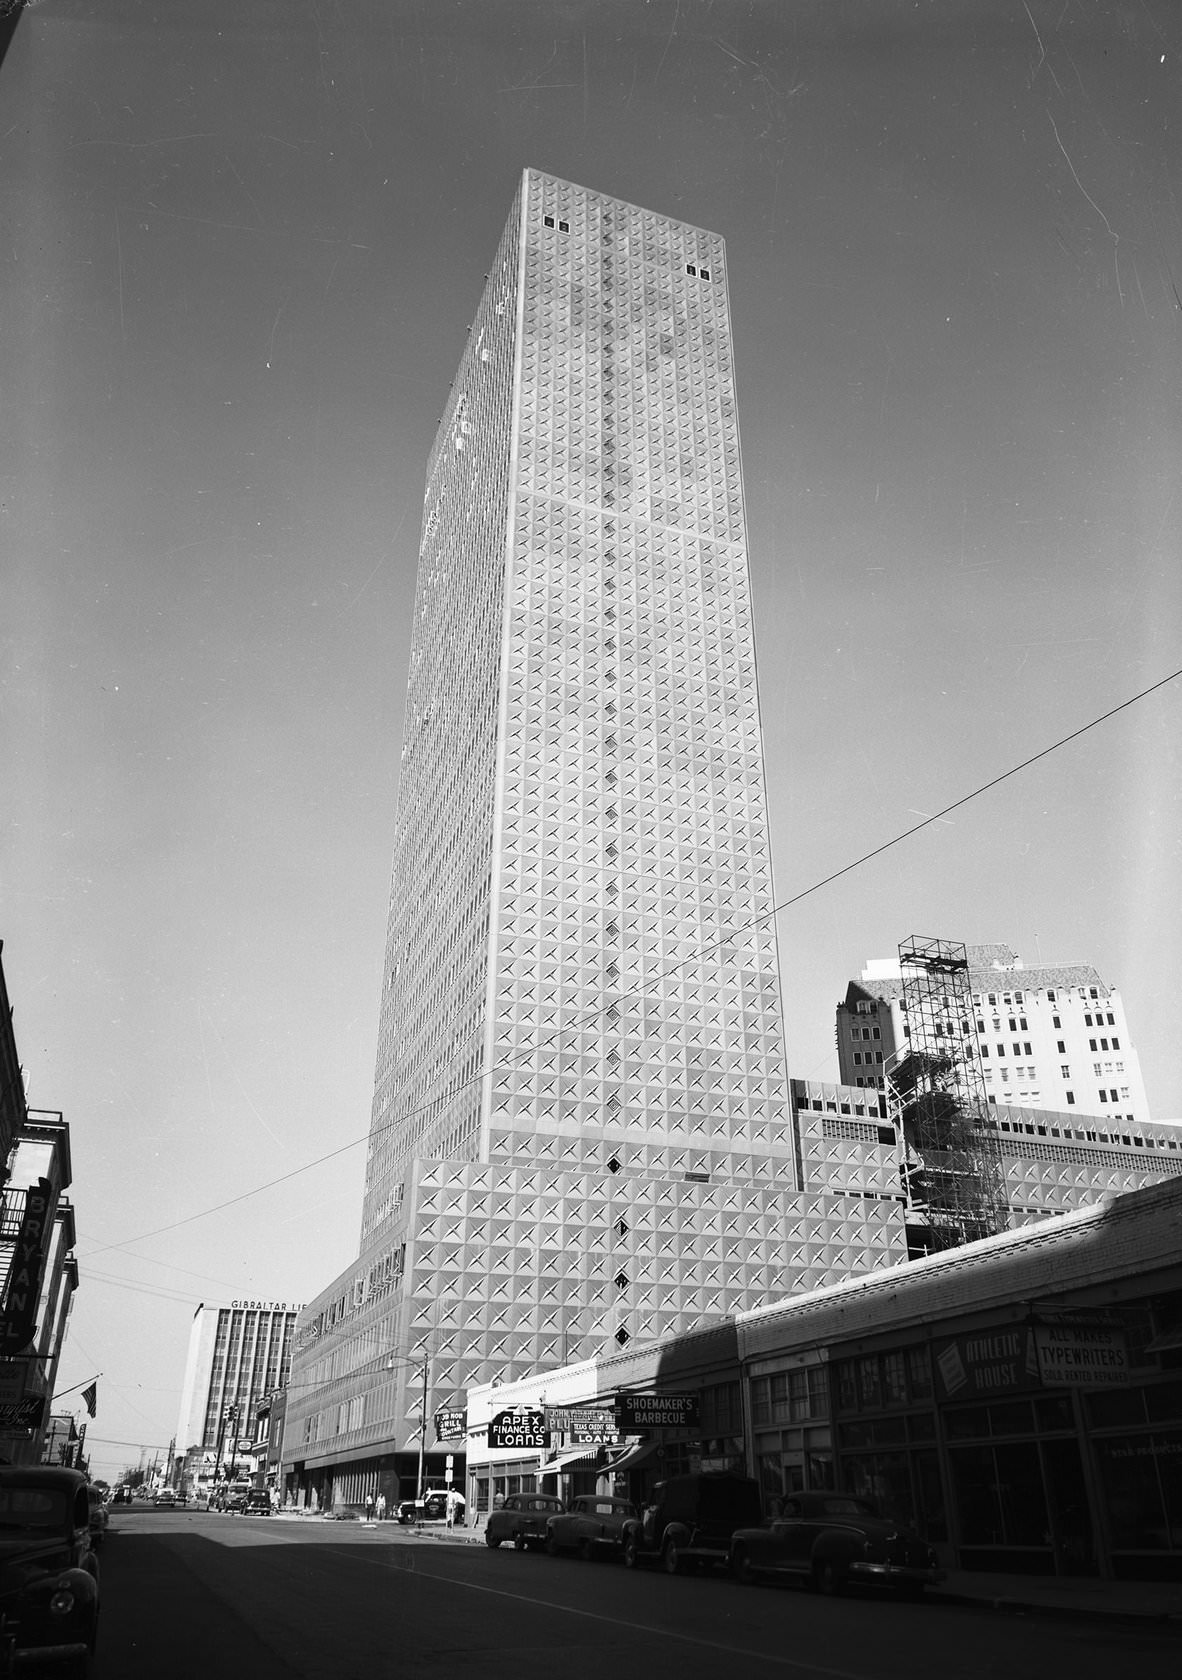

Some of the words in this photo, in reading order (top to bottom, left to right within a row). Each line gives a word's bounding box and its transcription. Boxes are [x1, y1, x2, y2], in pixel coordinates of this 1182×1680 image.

[10, 1196, 46, 1312] BRYAN
[231, 1300, 287, 1311] GIBRALTAR
[1049, 1328, 1070, 1342] ALL
[1073, 1329, 1113, 1345] MAKES
[966, 1332, 1021, 1363] ATHLETIC
[1041, 1346, 1124, 1366] TYPEWRITERS
[975, 1362, 1018, 1390] HOUSE
[626, 1398, 693, 1411] SHOEMAKER'S
[502, 1416, 541, 1425] APEX
[634, 1412, 686, 1424] BARBECUE
[493, 1425, 531, 1434] FINANCE
[532, 1425, 546, 1434] CO
[497, 1434, 544, 1446] LOANS
[578, 1435, 618, 1443] LOANS
